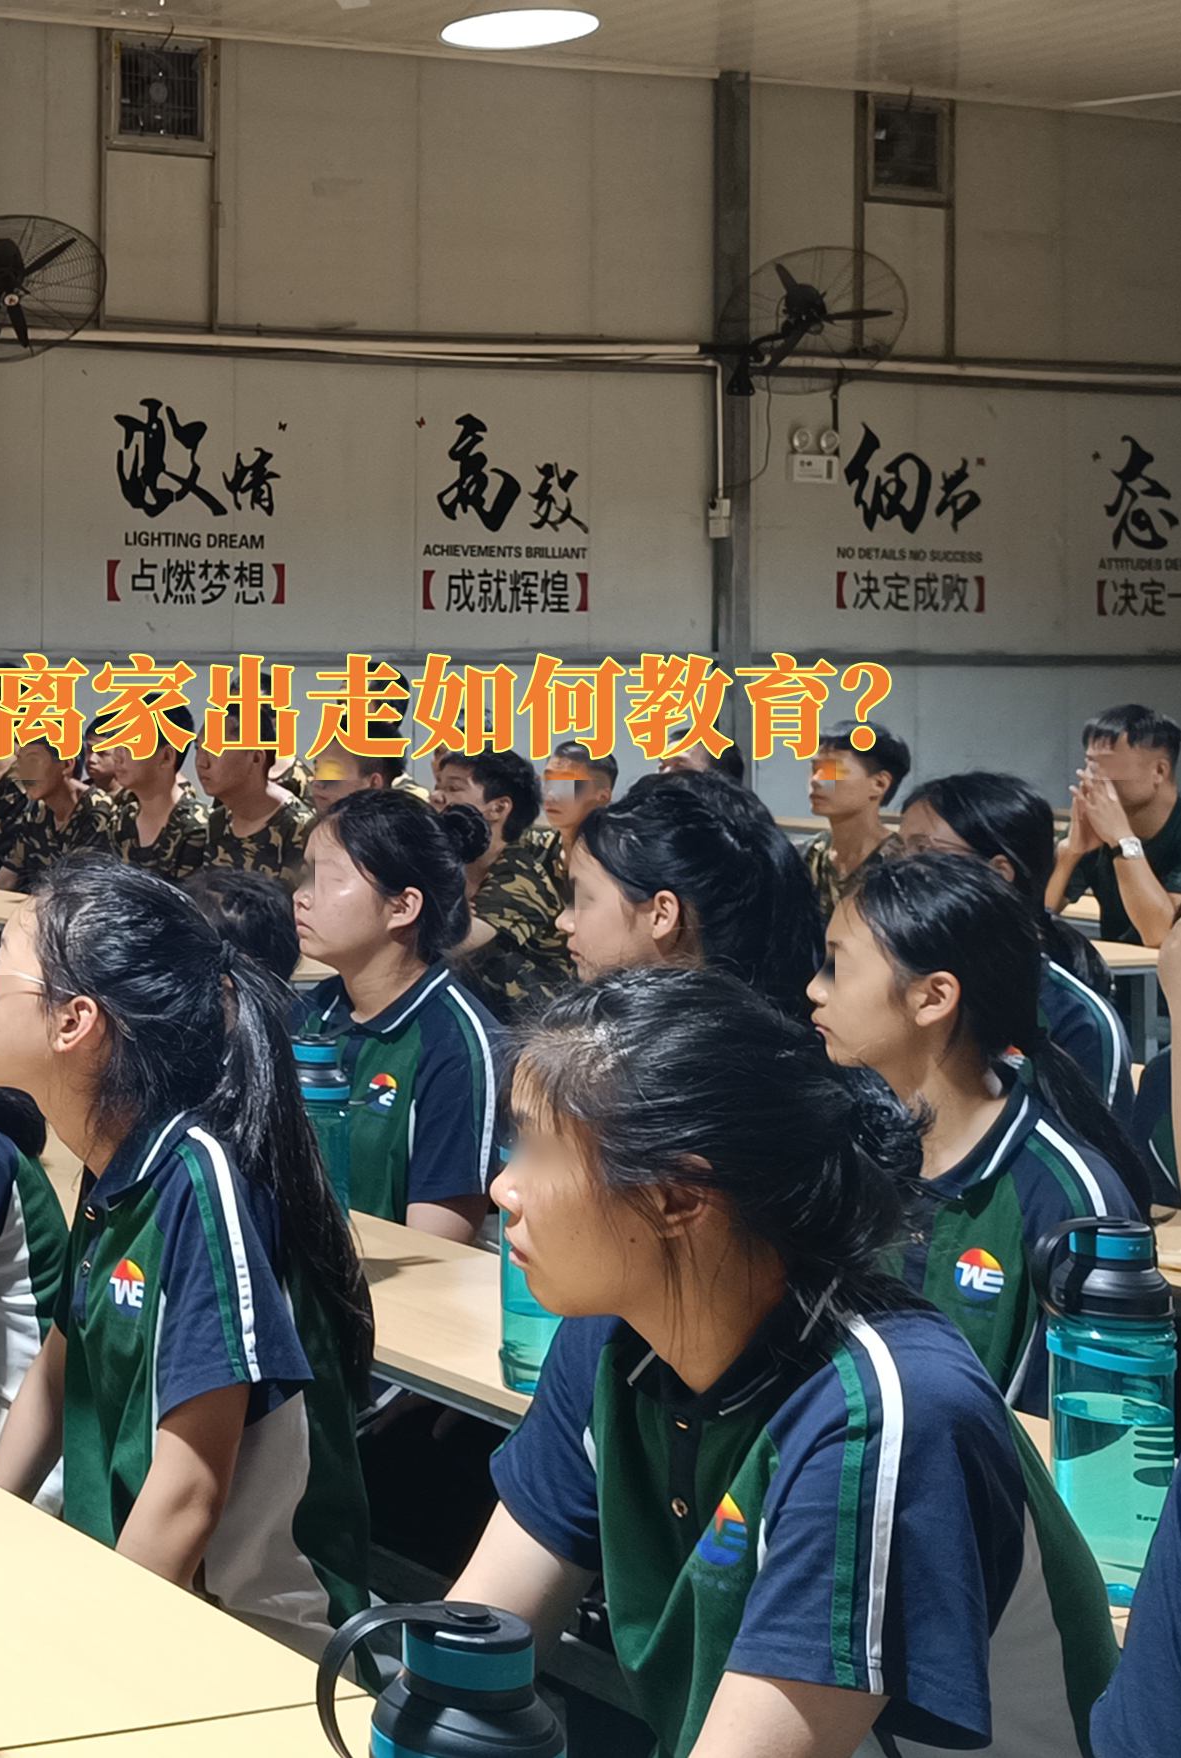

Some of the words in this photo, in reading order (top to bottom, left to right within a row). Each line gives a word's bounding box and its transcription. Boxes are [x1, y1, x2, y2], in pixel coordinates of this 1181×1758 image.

[114, 398, 282, 517] 激情
[437, 413, 590, 534] 高效
[124, 531, 202, 548] LIGHTING
[206, 533, 265, 550] DREAM
[422, 543, 522, 558] ACHIEVEMENTS
[525, 545, 588, 560] BRILLIANT
[836, 546, 856, 559] NO
[857, 547, 907, 561] DETAILS
[908, 548, 927, 562] NO
[929, 549, 983, 564] SUCCESS
